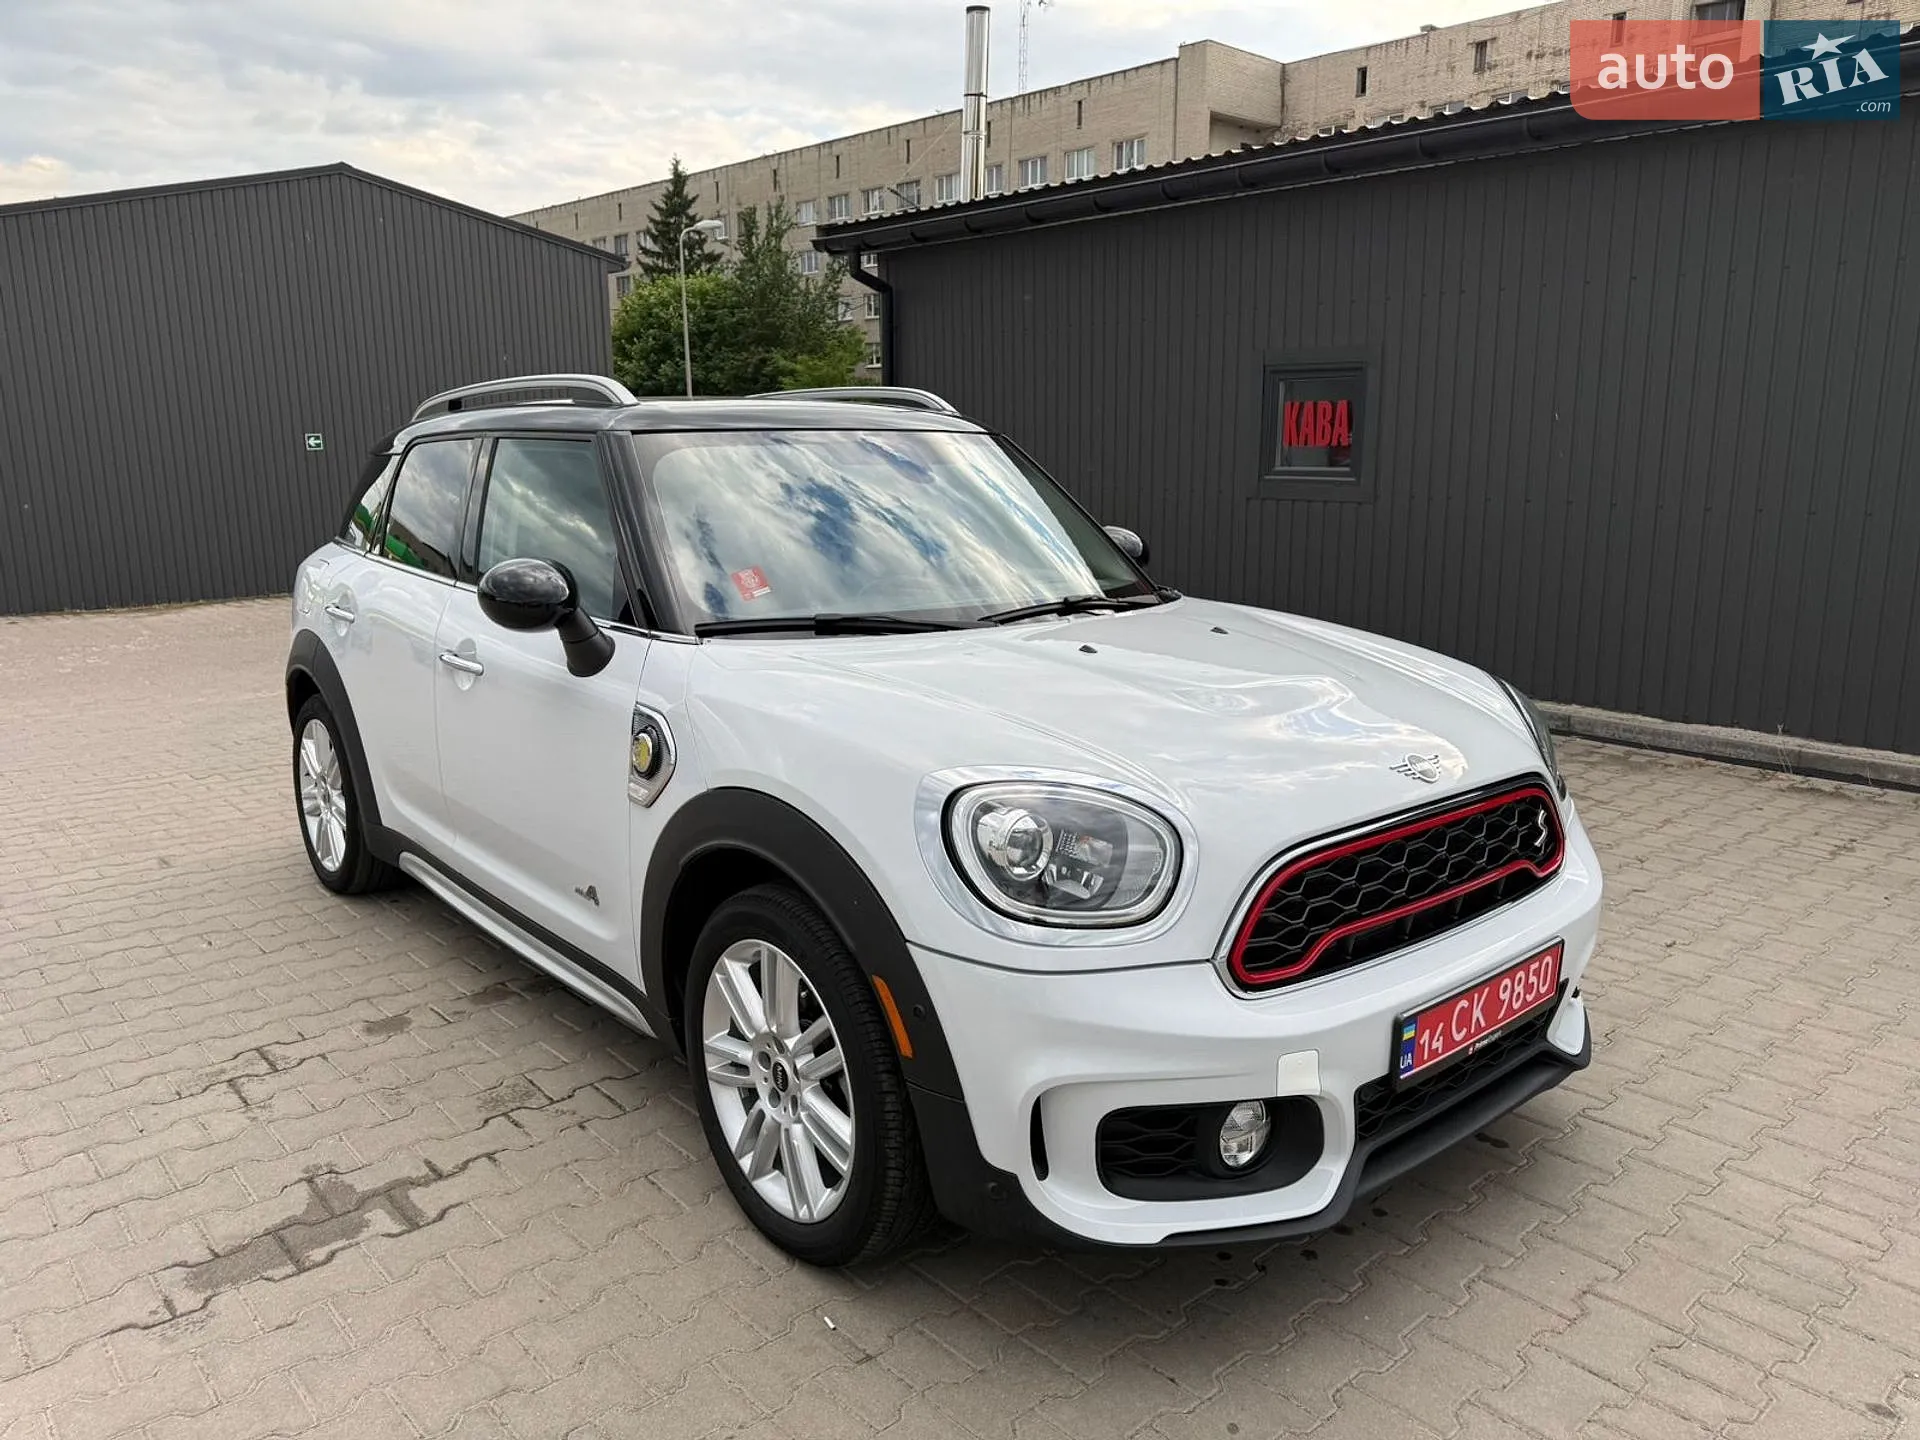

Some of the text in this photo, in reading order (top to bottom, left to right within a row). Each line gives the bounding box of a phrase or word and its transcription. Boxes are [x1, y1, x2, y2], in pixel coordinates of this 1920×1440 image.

[1420, 1022, 1444, 1060] 14
[1451, 987, 1490, 1042] CK
[1497, 955, 1553, 1020] 9850
[1400, 1052, 1413, 1069] UA
